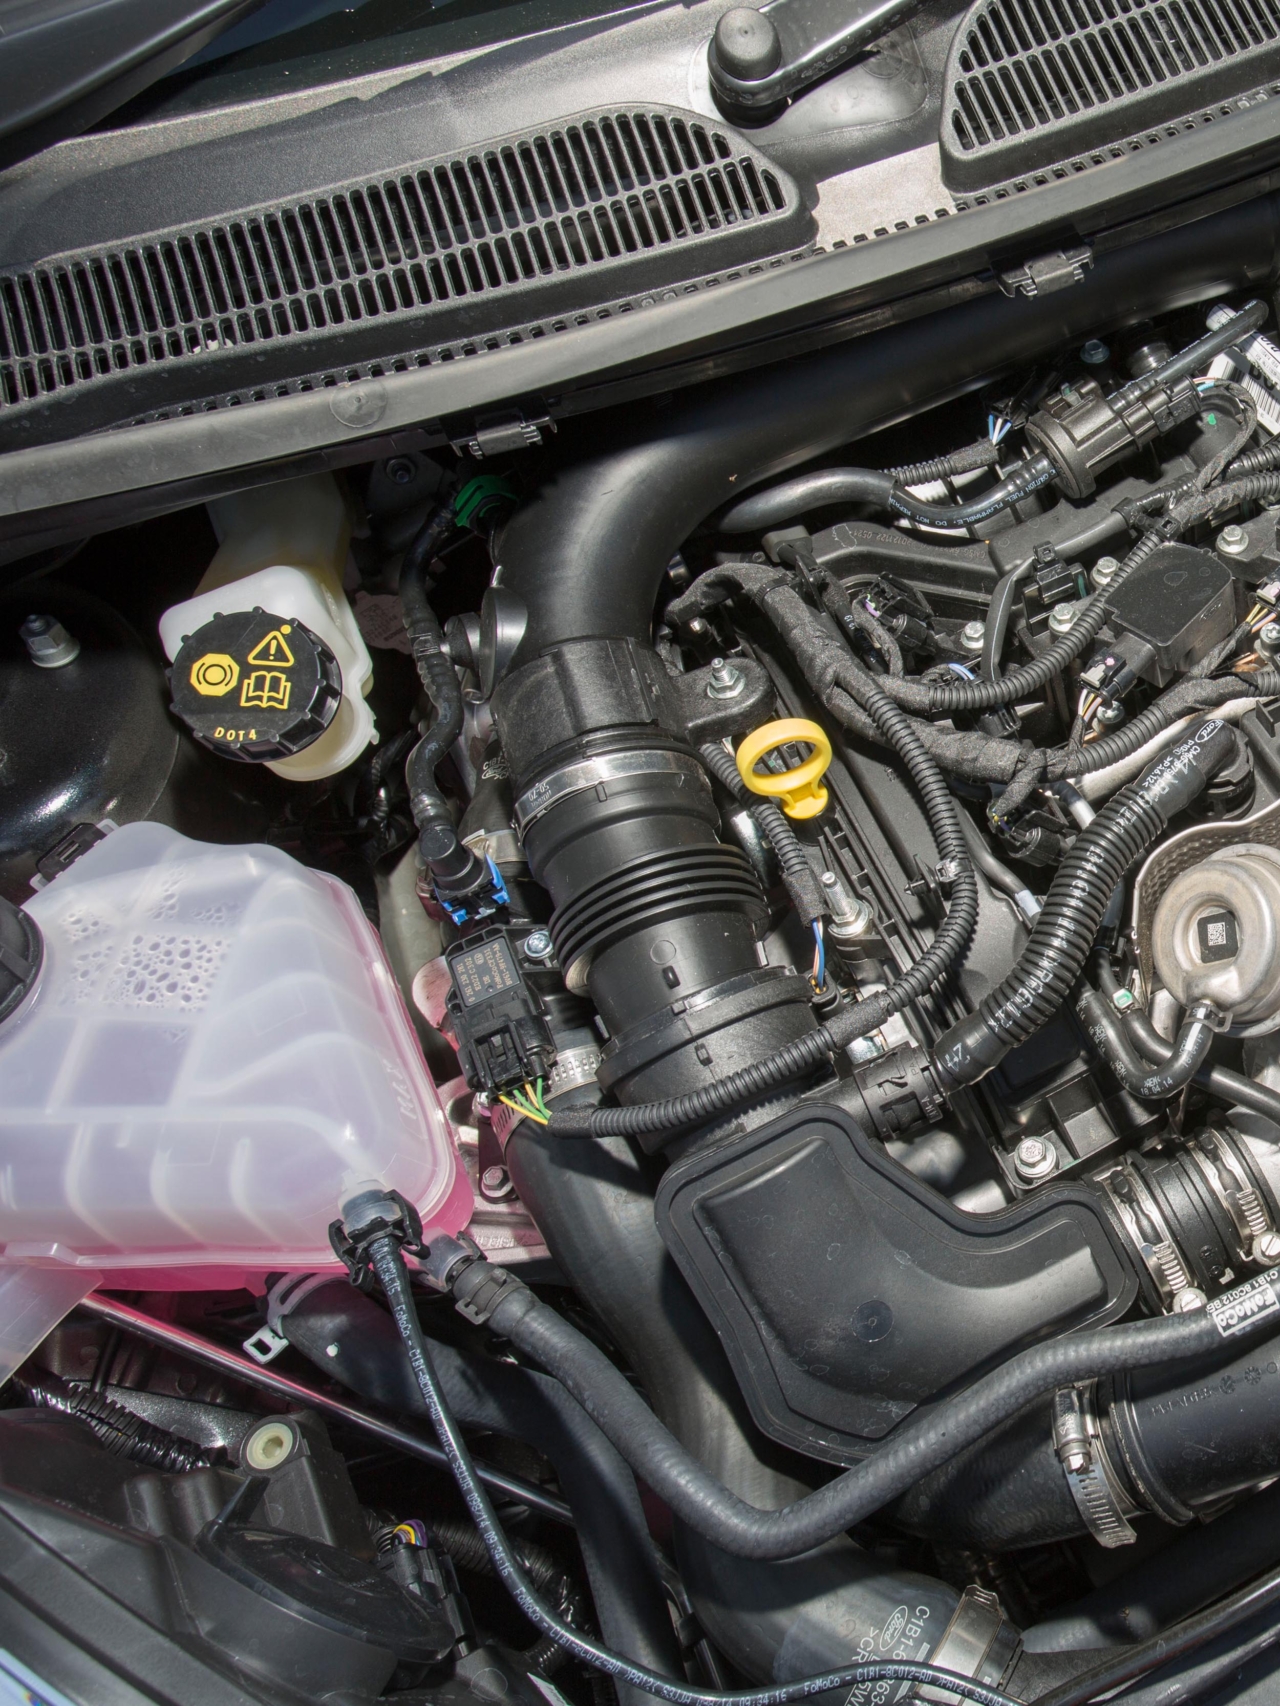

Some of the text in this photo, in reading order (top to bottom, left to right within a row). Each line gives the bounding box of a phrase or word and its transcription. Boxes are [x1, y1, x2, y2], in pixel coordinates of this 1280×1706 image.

[1004, 489, 1024, 504] FUEL
[914, 513, 930, 524] NOT
[1139, 1076, 1173, 1095] 18.04.14
[1250, 1268, 1279, 1289] C1B1
[1220, 1282, 1252, 1305] 8C012
[1214, 1286, 1276, 1330] FoMoCo
[392, 1303, 413, 1337] FoMoCo
[512, 1585, 541, 1622] FoMoCo
[803, 1674, 841, 1695] FoMoCo
